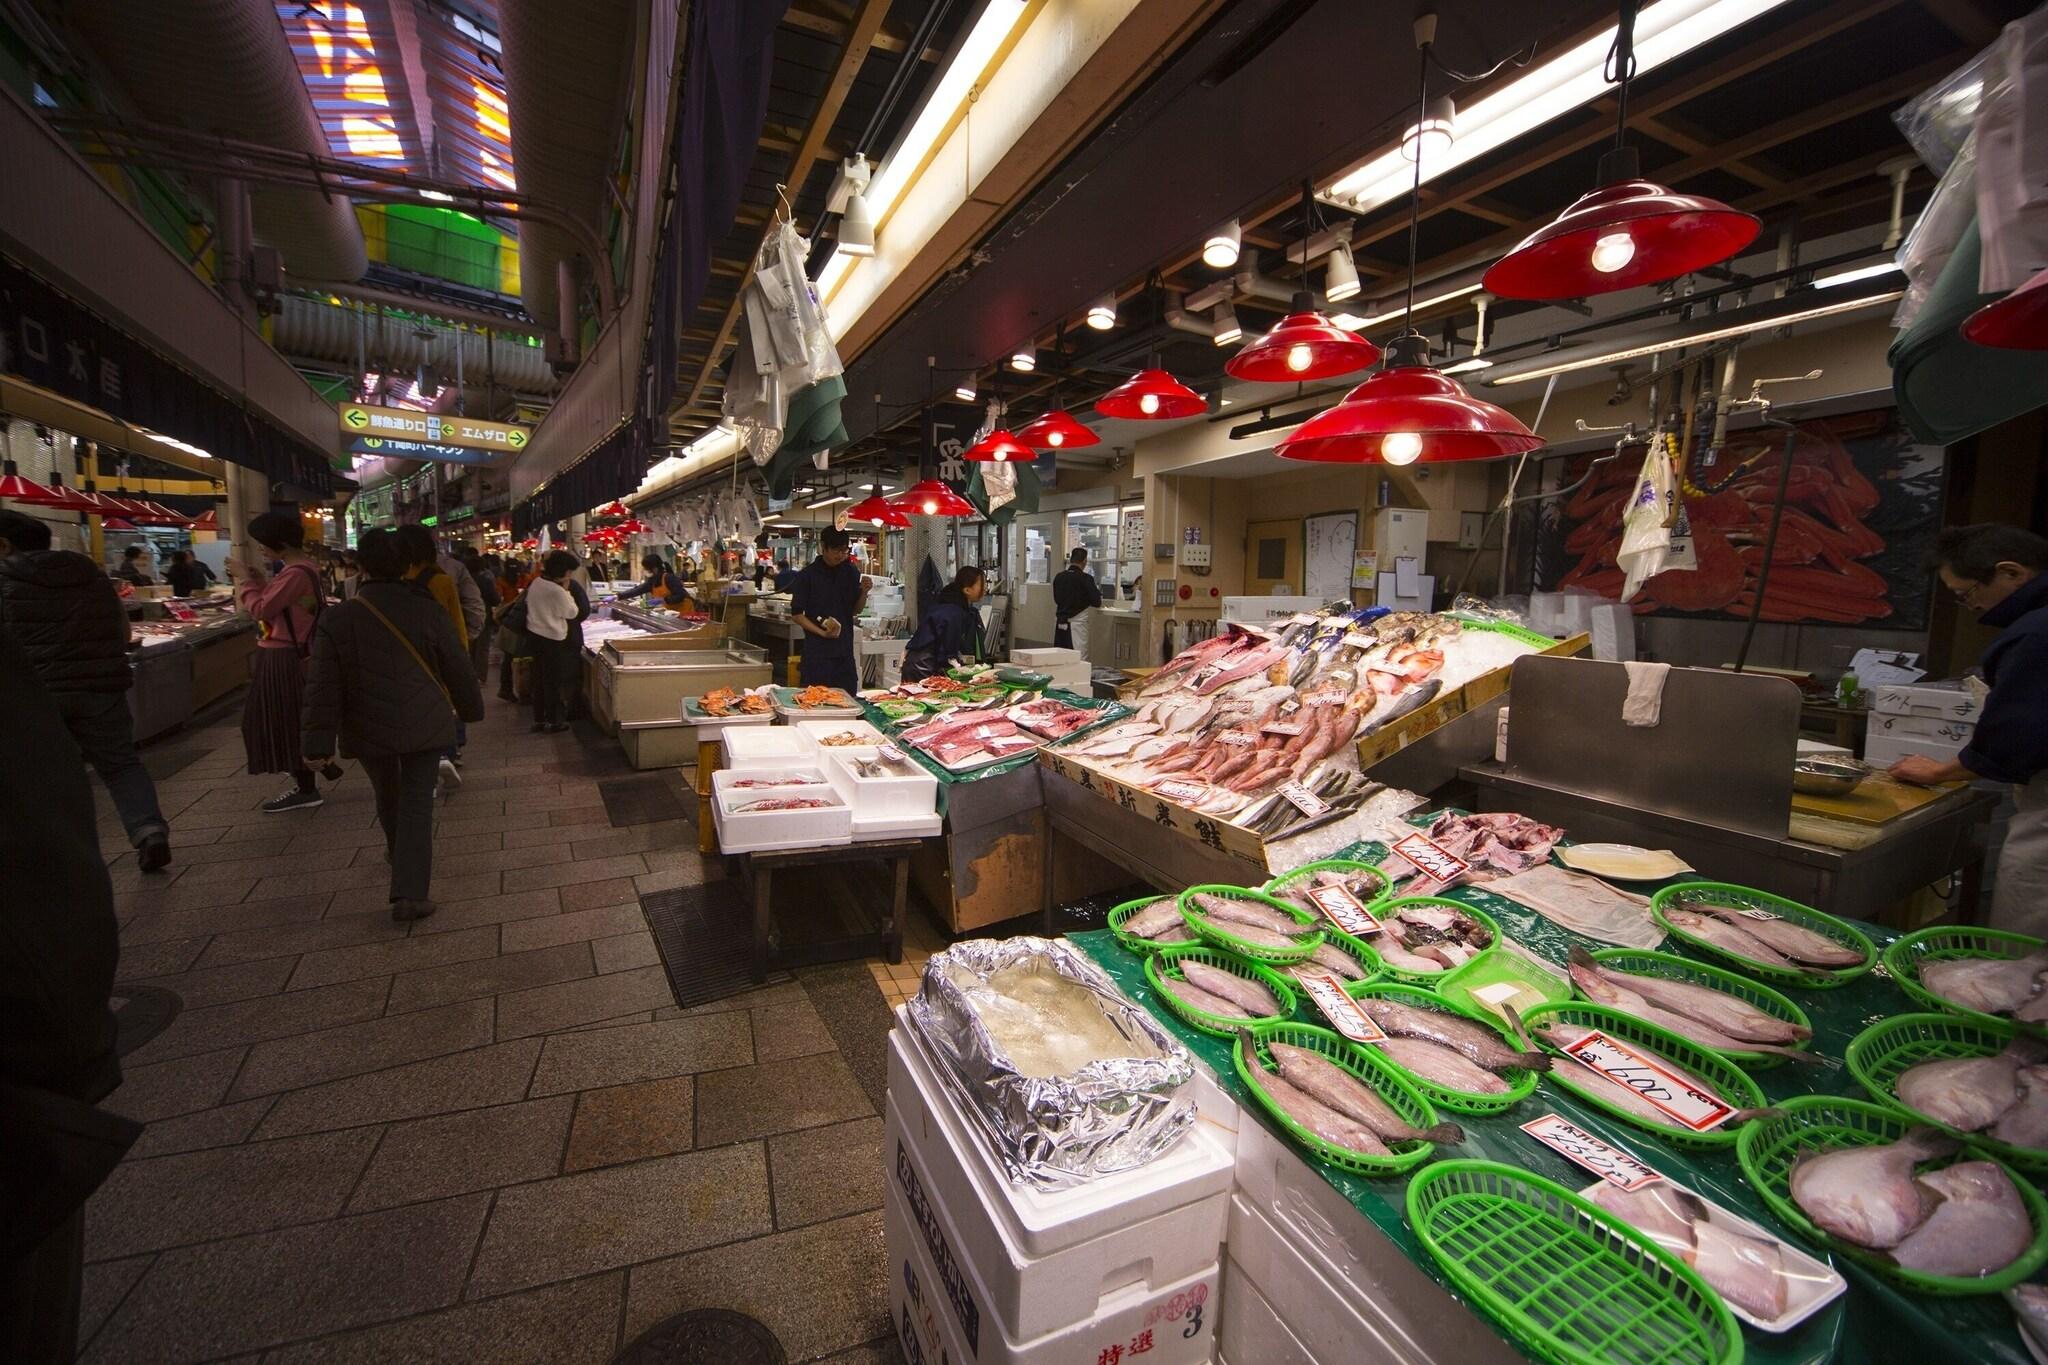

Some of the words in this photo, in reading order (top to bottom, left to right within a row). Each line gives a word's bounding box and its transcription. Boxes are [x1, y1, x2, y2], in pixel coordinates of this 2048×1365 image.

[370, 414, 426, 433] 鮮魚通り口
[461, 427, 507, 443] エムザ口
[1182, 1303, 1203, 1340] 3
